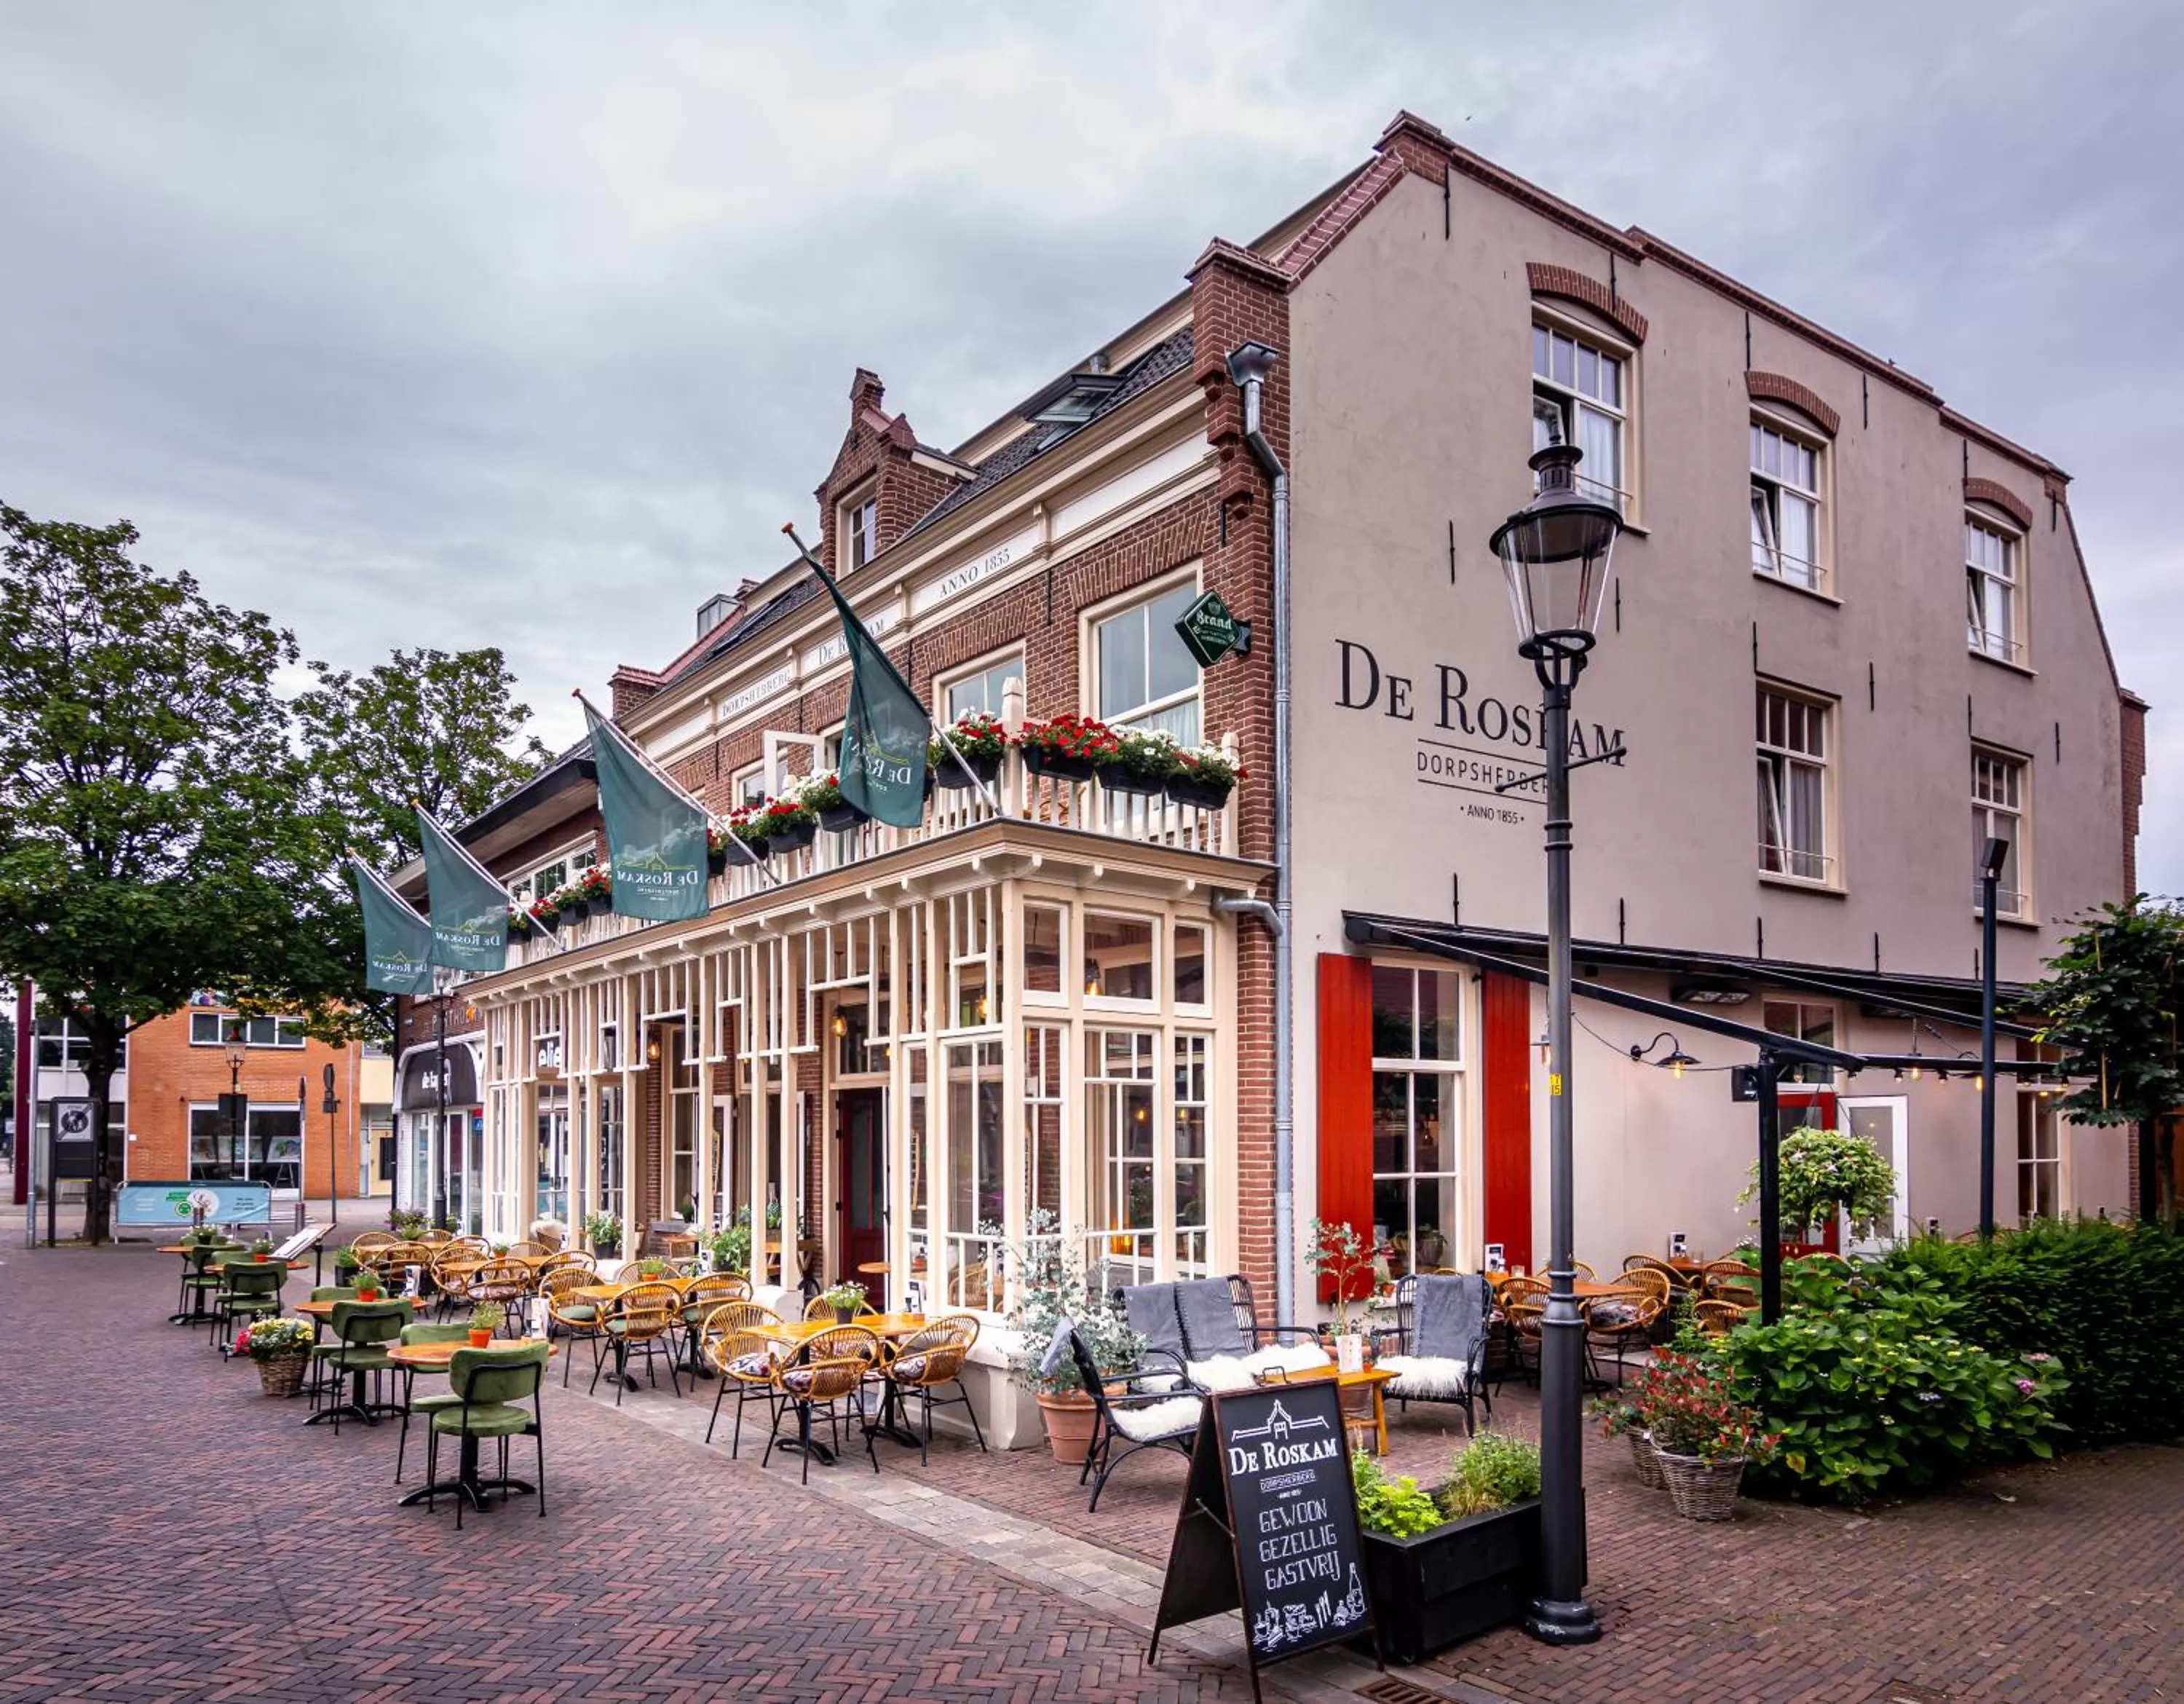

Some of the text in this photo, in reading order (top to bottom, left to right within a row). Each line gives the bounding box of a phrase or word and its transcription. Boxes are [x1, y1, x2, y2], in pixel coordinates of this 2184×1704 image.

[939, 548, 1010, 597] ANNO 1855
[1197, 610, 1232, 630] Brand
[1467, 805, 1518, 824] ANNO 1855
[1261, 1438, 1338, 1470] ROSKAM
[1259, 1499, 1327, 1532] GEWOON
[1259, 1523, 1337, 1561] GEZELLIG
[1265, 1550, 1340, 1590] GASTVRIJ
